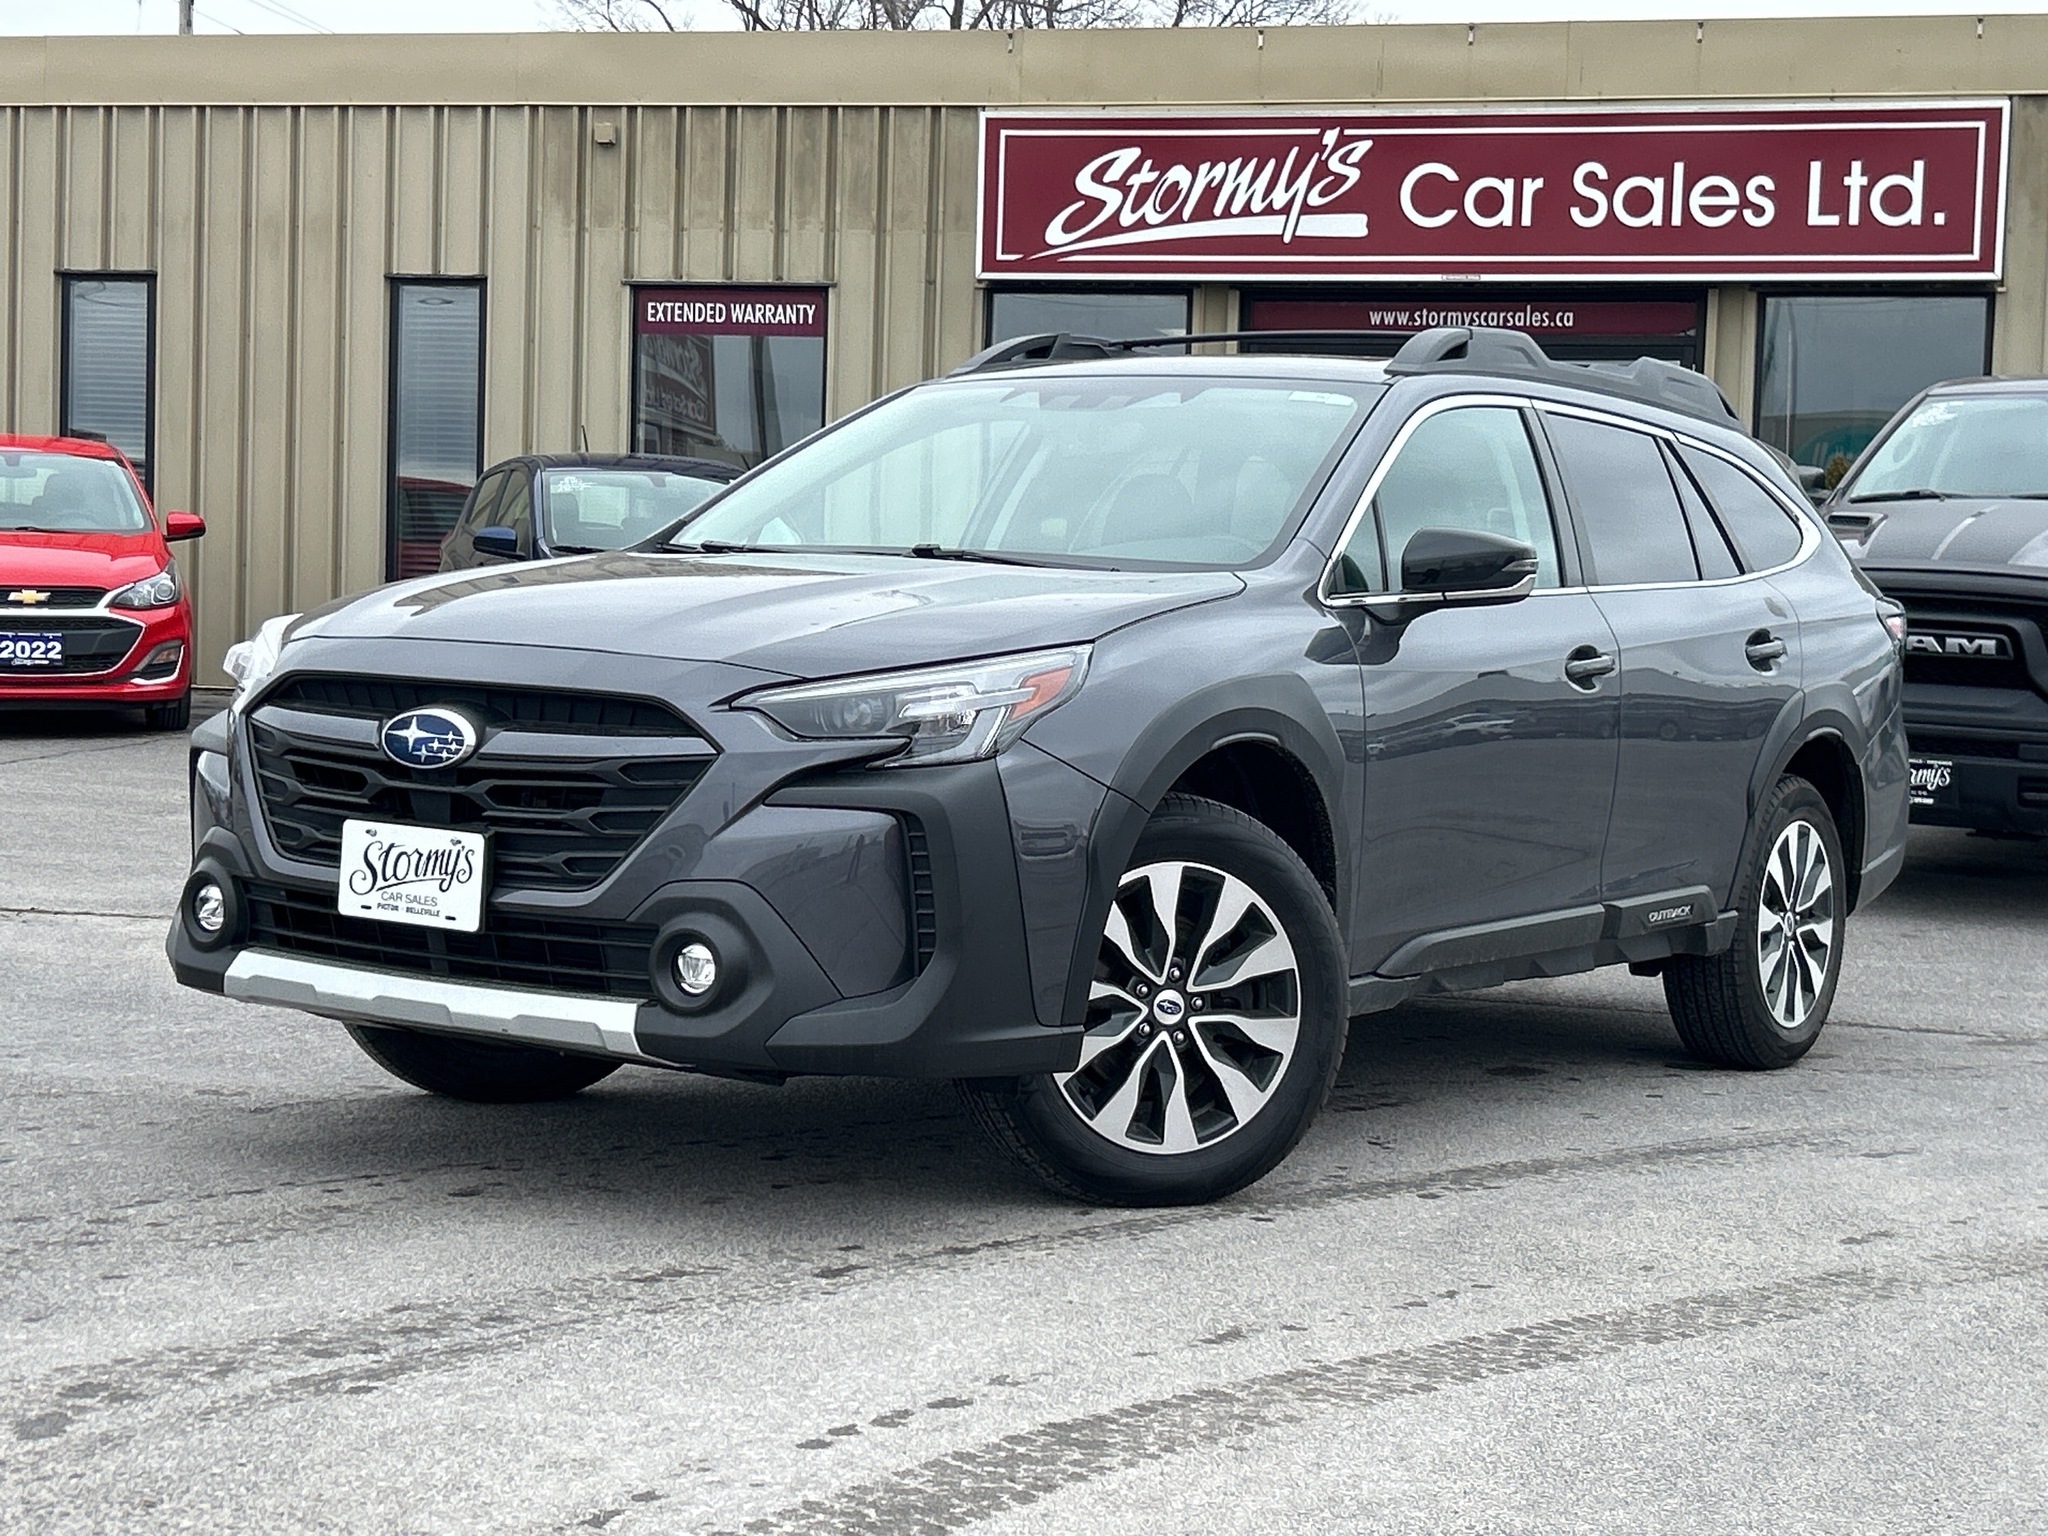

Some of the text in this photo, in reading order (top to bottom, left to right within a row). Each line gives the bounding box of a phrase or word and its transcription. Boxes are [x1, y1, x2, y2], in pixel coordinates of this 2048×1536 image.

[1044, 126, 1947, 246] Stormy's Car Sales Ltd.
[647, 302, 816, 325] EXTENDED WARRANTY
[1369, 304, 1575, 328] www.stormyscarsales.ca
[0, 640, 62, 660] 2022
[1905, 634, 1998, 656] AM
[349, 840, 475, 895] Stormy's
[381, 891, 438, 907] CAR SALES
[1648, 904, 1692, 923] OUTBACK
